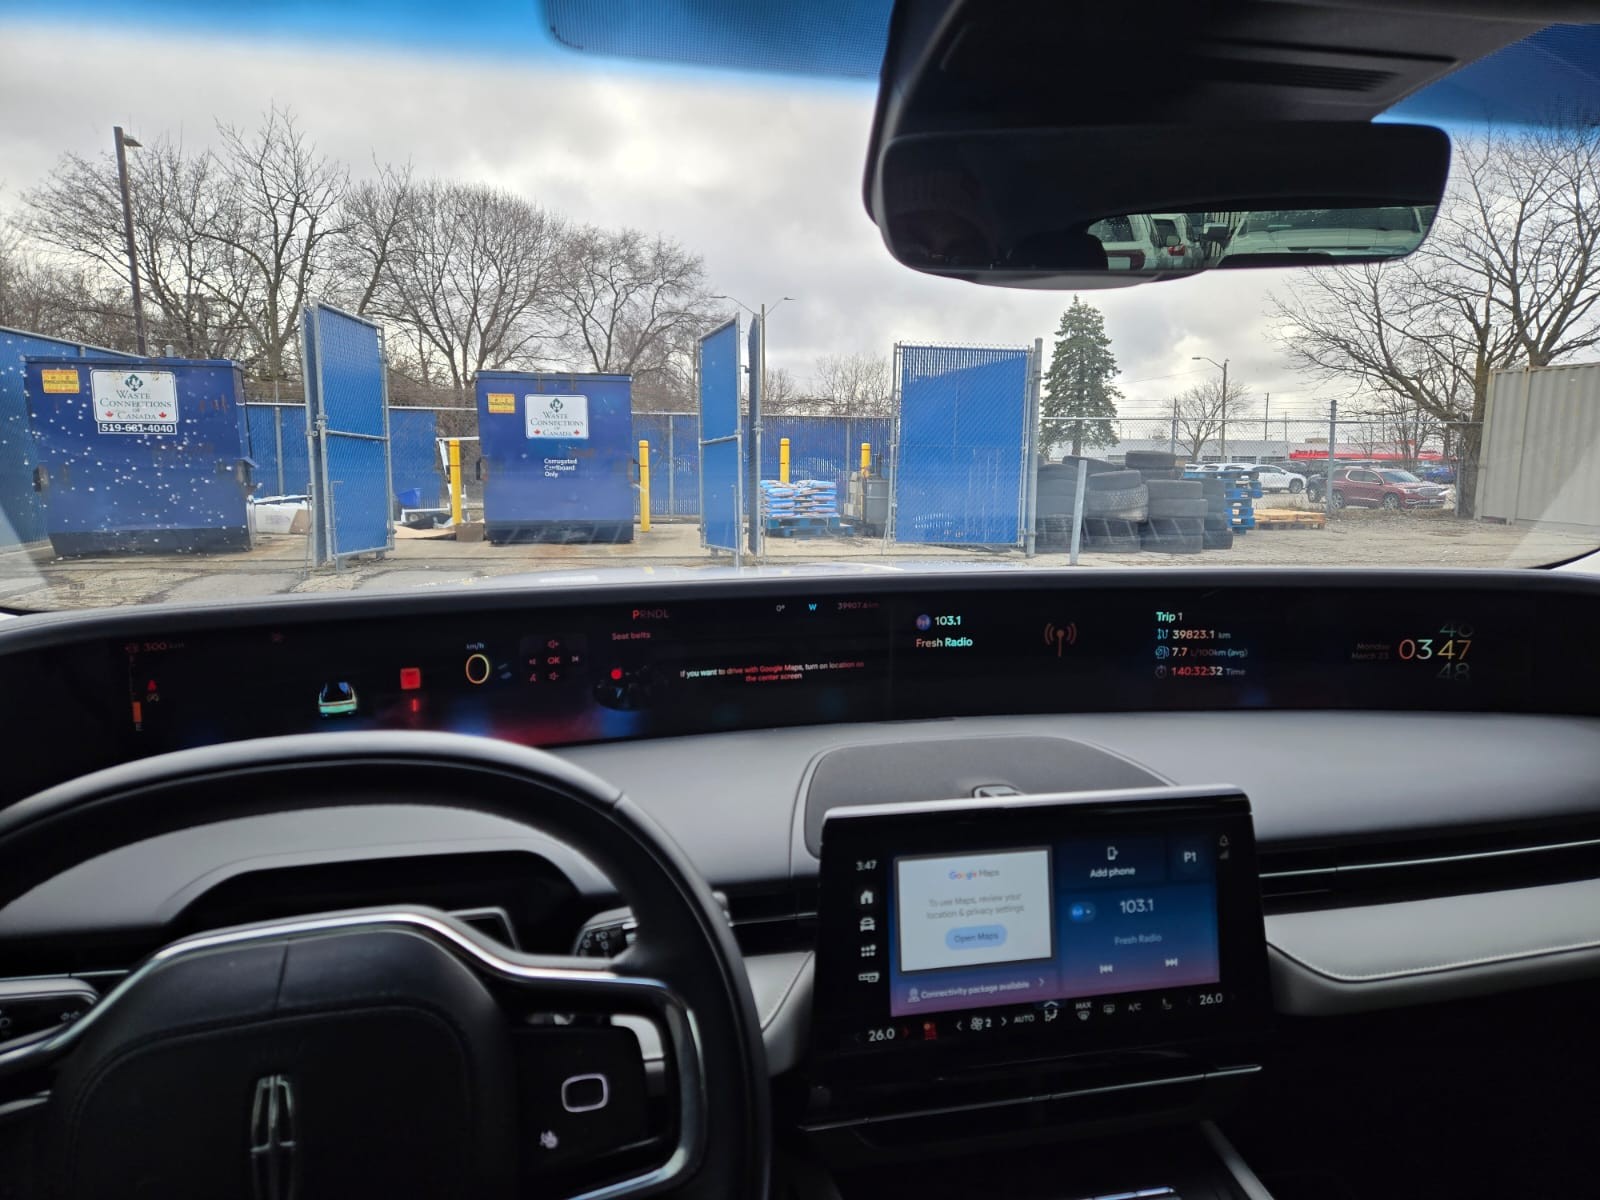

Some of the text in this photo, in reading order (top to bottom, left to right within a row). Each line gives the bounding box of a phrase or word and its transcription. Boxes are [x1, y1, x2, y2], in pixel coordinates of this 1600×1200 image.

[116, 389, 151, 400] WASTE
[100, 397, 172, 408] CONNECTIONS
[117, 410, 157, 420] CANADA
[543, 410, 568, 420] WASTE
[530, 417, 584, 427] CONNECTIONS
[542, 429, 572, 437] CANADA
[544, 471, 559, 479] Only
[809, 603, 817, 611] W
[935, 615, 962, 626] 103.1
[1156, 611, 1183, 623] Trip 1
[612, 630, 651, 640] Seat belts
[1172, 630, 1231, 639] 39823.1 km
[466, 642, 485, 650] km/h
[915, 637, 973, 648] Fresh Radio
[1172, 647, 1188, 657] 7.7
[547, 656, 561, 665] OK
[686, 670, 699, 679] you
[700, 669, 717, 677] want
[718, 668, 726, 676] to
[727, 667, 743, 675] drive
[744, 666, 759, 674] with
[760, 665, 784, 674] Google
[805, 662, 818, 670] turn
[819, 662, 828, 670] on
[829, 661, 855, 669] location
[1226, 667, 1246, 676] Time
[745, 673, 802, 683] the center screen
[1184, 852, 1197, 863] P1
[856, 861, 877, 871] 3:47
[949, 869, 1000, 880] Google Maps
[1090, 867, 1136, 879] Add phone
[1120, 898, 1154, 914] 103.1
[966, 907, 993, 918] privacy
[954, 932, 999, 944] Open Maps
[1114, 934, 1162, 945] Fresh Radio
[921, 981, 1030, 999] Connectivity package available
[1199, 993, 1223, 1005] 26.0
[1075, 1001, 1092, 1009] MAX
[1128, 1003, 1142, 1011] A/C
[985, 1018, 992, 1028] 2
[1014, 1014, 1036, 1024] AUTO
[868, 1028, 896, 1042] 26.0
